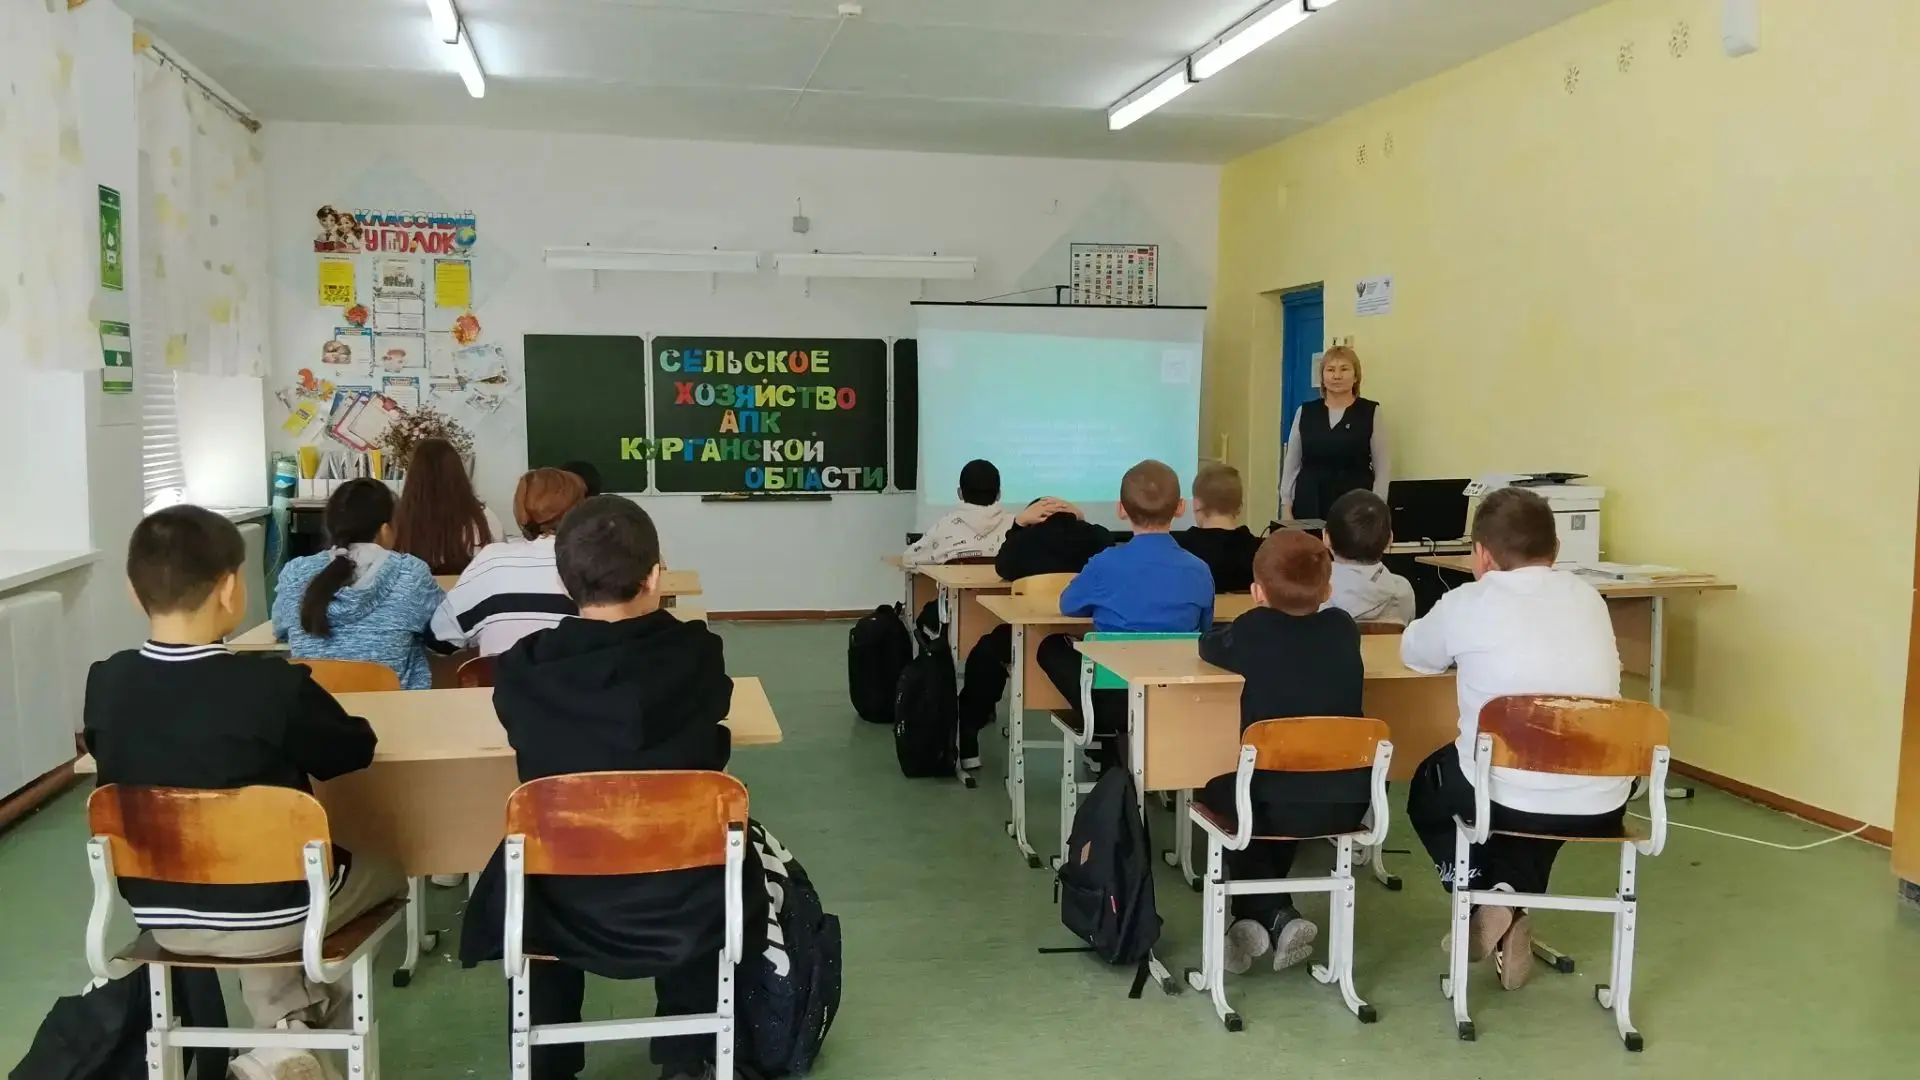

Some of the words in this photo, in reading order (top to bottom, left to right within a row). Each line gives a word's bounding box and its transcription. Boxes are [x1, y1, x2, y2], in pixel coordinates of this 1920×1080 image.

[354, 208, 476, 230] КЛАССНЫЙ
[363, 229, 457, 254] УГОЛОК
[659, 349, 830, 374] СЕЛЬСКОЕ
[674, 379, 857, 411] ХОЗЯЙСТВО
[719, 408, 781, 434] АПК
[620, 431, 824, 463] КУРГАНСКОЙ
[744, 466, 884, 490] ОБЛАСТИ
